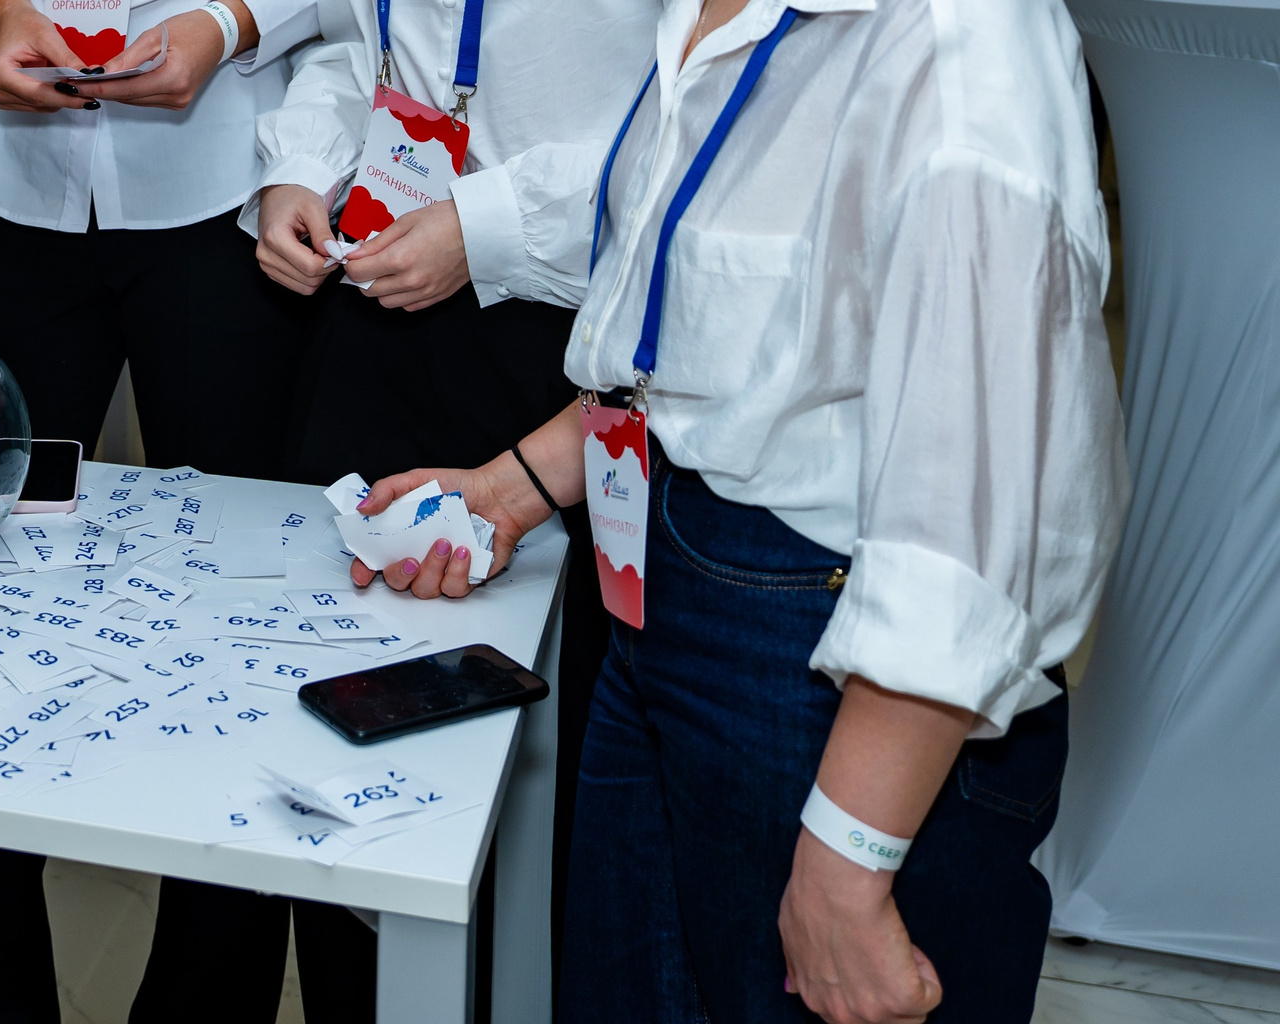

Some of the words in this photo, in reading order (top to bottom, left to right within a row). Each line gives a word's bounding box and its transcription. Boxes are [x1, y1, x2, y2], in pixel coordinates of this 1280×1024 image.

[52, 0, 122, 11] ОРГАНИЗАТОР
[160, 472, 200, 483] 270
[107, 505, 143, 519] 270
[181, 497, 201, 514] 287
[22, 526, 47, 541] 227
[174, 517, 195, 536] 287
[592, 512, 639, 538] ОРГАНИЗАТОР
[75, 541, 98, 561] 245
[83, 578, 104, 594] 128
[127, 577, 176, 602] 249
[312, 593, 338, 606] 53
[33, 612, 83, 629] 283
[146, 618, 181, 631] 32
[228, 616, 279, 629] 249
[333, 617, 360, 630] 53
[94, 627, 146, 649] 283
[27, 649, 58, 666] 63
[172, 652, 205, 668] 92
[274, 664, 309, 679] 93
[28, 698, 71, 722] 278
[104, 698, 150, 722] 253
[343, 784, 400, 808] 263
[868, 842, 901, 859] СБЕР
